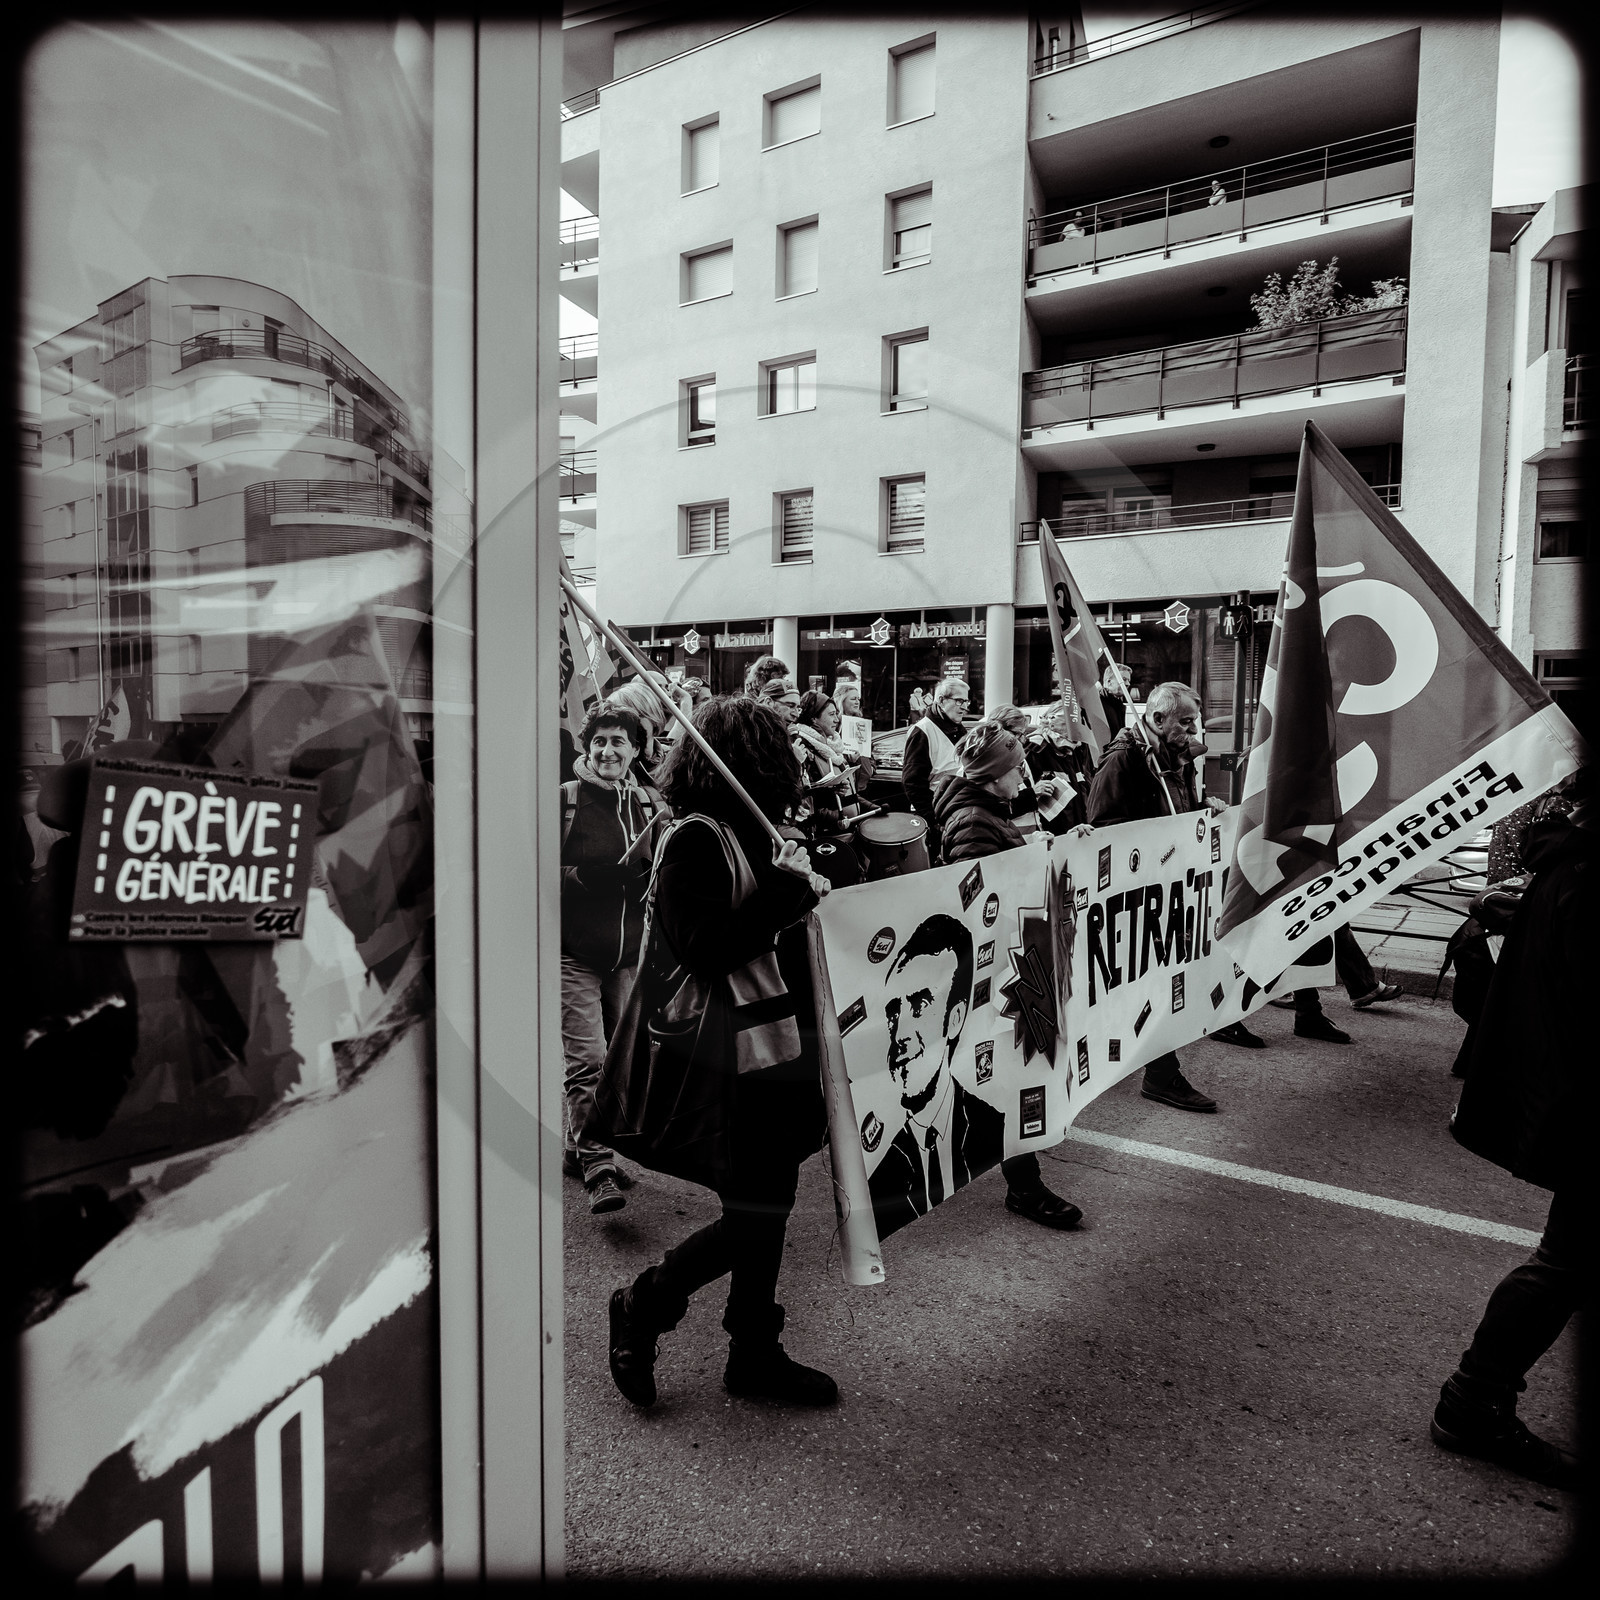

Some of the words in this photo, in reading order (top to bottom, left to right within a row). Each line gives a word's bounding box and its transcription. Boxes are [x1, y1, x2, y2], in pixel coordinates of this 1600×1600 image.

[909, 620, 986, 638] Matmut
[95, 760, 182, 777] Mobilisations
[123, 781, 282, 857] GRÈVE
[115, 852, 280, 904] GÉNÉRALE
